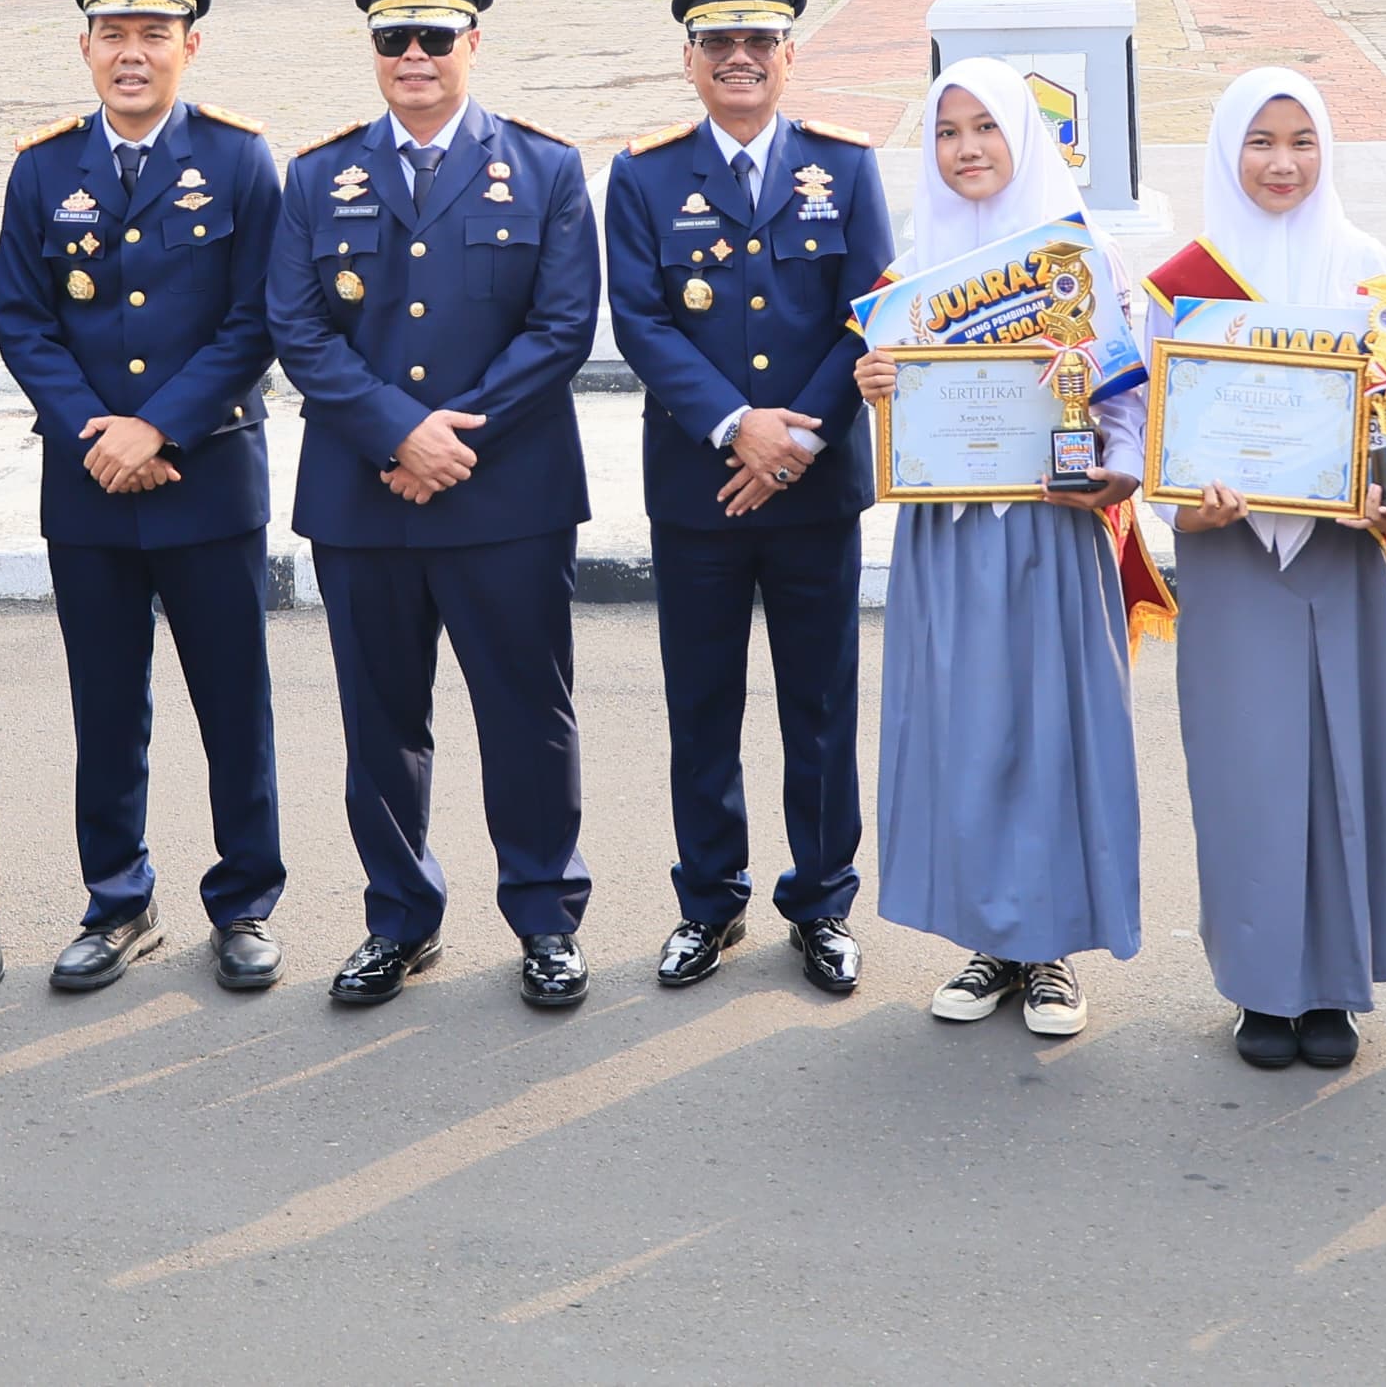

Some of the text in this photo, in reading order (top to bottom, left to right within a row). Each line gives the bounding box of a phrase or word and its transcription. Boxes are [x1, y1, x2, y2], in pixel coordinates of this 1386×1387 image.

[964, 298, 1046, 339] UANG PEMBINAAN
[939, 385, 1027, 400] SERTIFIKAT
[1214, 386, 1303, 407] SERTIFIKAT
